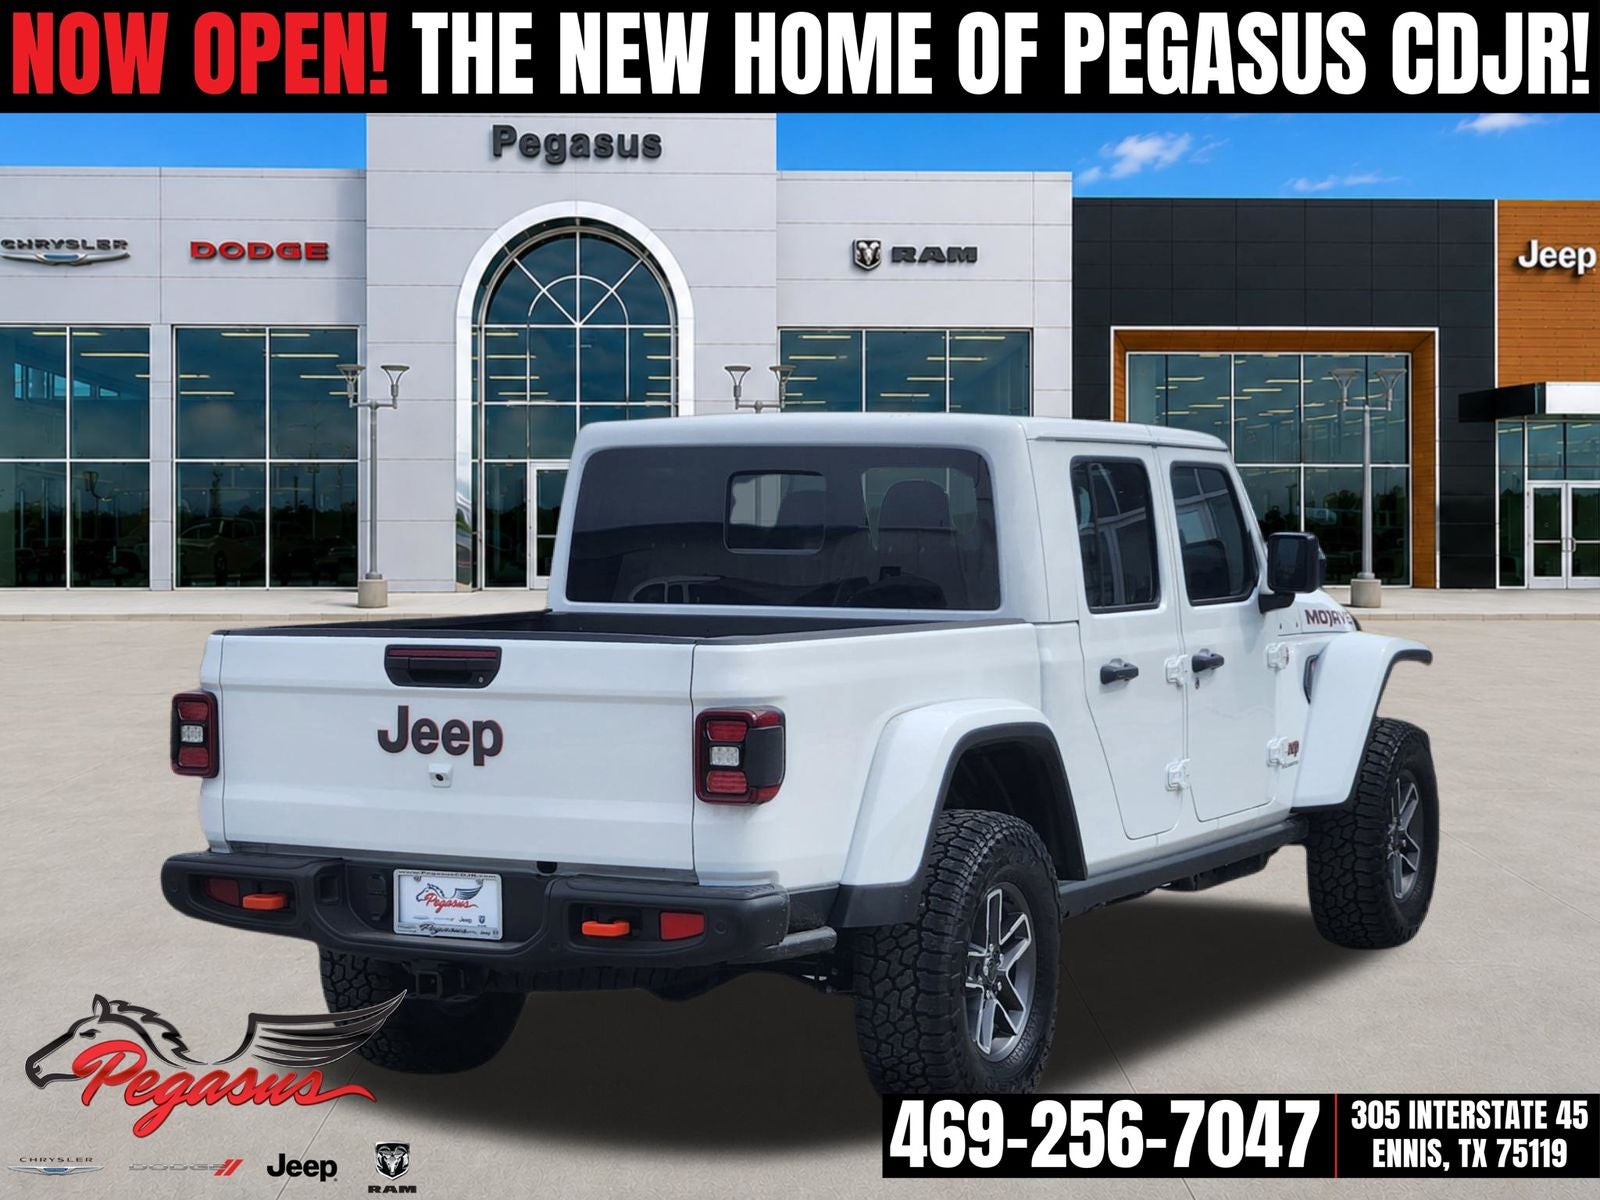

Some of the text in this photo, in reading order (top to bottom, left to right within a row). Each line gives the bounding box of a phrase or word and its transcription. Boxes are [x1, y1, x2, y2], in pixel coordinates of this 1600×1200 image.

[491, 124, 662, 165] Pegasus
[0, 237, 129, 251] CHRYSLER
[190, 240, 329, 261] DODGE
[891, 246, 978, 264] RAM
[1518, 239, 1597, 275] Jeep
[377, 705, 504, 766] Jeep
[424, 893, 479, 914] Pegasus
